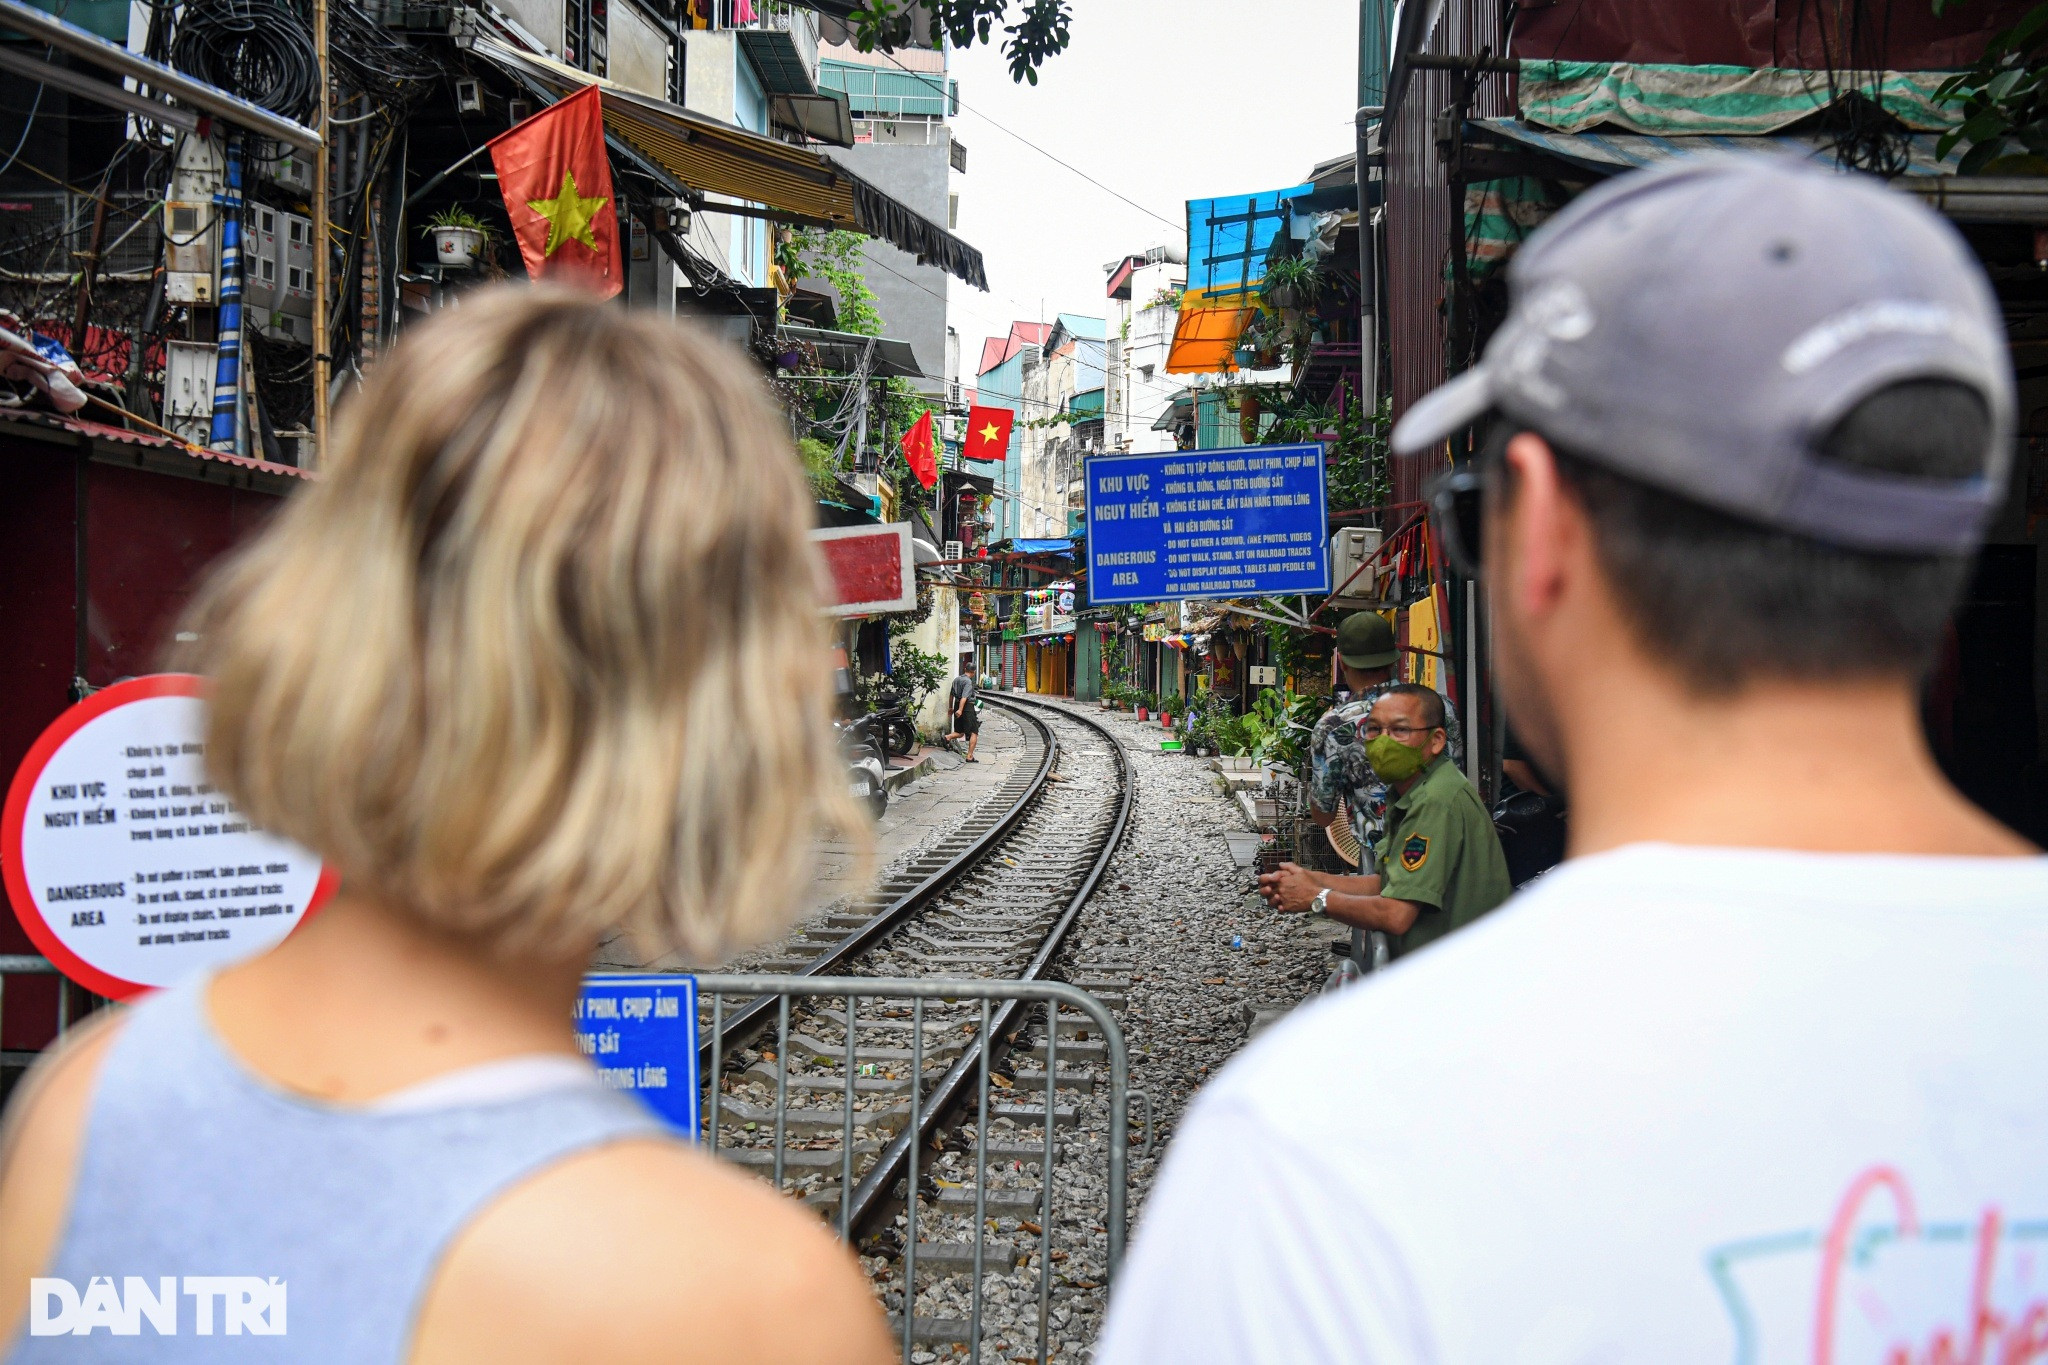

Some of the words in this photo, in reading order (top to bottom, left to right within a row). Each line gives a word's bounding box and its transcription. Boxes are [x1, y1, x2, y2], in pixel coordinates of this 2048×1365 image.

[1099, 477, 1123, 493] KHU
[1126, 474, 1149, 495] VỰC
[1095, 504, 1125, 521] NGUY
[1130, 496, 1159, 519] HIỂM
[1168, 540, 1176, 549] DO
[1178, 539, 1189, 549] NOT
[1191, 538, 1214, 548] GATHER
[1215, 537, 1220, 546] A
[1221, 536, 1245, 546] CROWD,
[1263, 533, 1289, 543] PHOTOS,
[1290, 532, 1312, 542] VIDEOS
[1097, 551, 1156, 566] DANGEROUS
[1168, 554, 1177, 564] DO
[1178, 553, 1190, 563] NOT
[1191, 552, 1211, 562] WALK,
[1212, 551, 1234, 561] STAND,
[1235, 550, 1245, 560] SIT
[1246, 549, 1255, 559] ON
[1256, 548, 1286, 558] RAILROAD
[1287, 547, 1312, 557] TRACKS
[1178, 568, 1191, 578] NOT
[1192, 567, 1217, 577] DISPLAY
[1218, 565, 1243, 575] CHAIRS,
[1244, 564, 1267, 574] TABLES
[1268, 563, 1281, 573] AND
[1306, 561, 1316, 571] ON
[1112, 572, 1139, 586] AREA
[1166, 583, 1179, 593] AND
[1180, 582, 1200, 592] ALONG
[1201, 580, 1231, 591] RAILROAD
[1232, 579, 1256, 589] TRACKS
[51, 784, 77, 800] KHU
[81, 781, 107, 801] VỰC
[45, 811, 79, 827] NGUY
[83, 802, 116, 825] HIỂM
[47, 882, 126, 902] DANGEROUS
[71, 910, 105, 926] AREA
[587, 997, 621, 1021] PHIM,
[622, 997, 653, 1023] CHỤP
[654, 988, 679, 1018] ẢNH
[598, 1025, 621, 1055] SẮT
